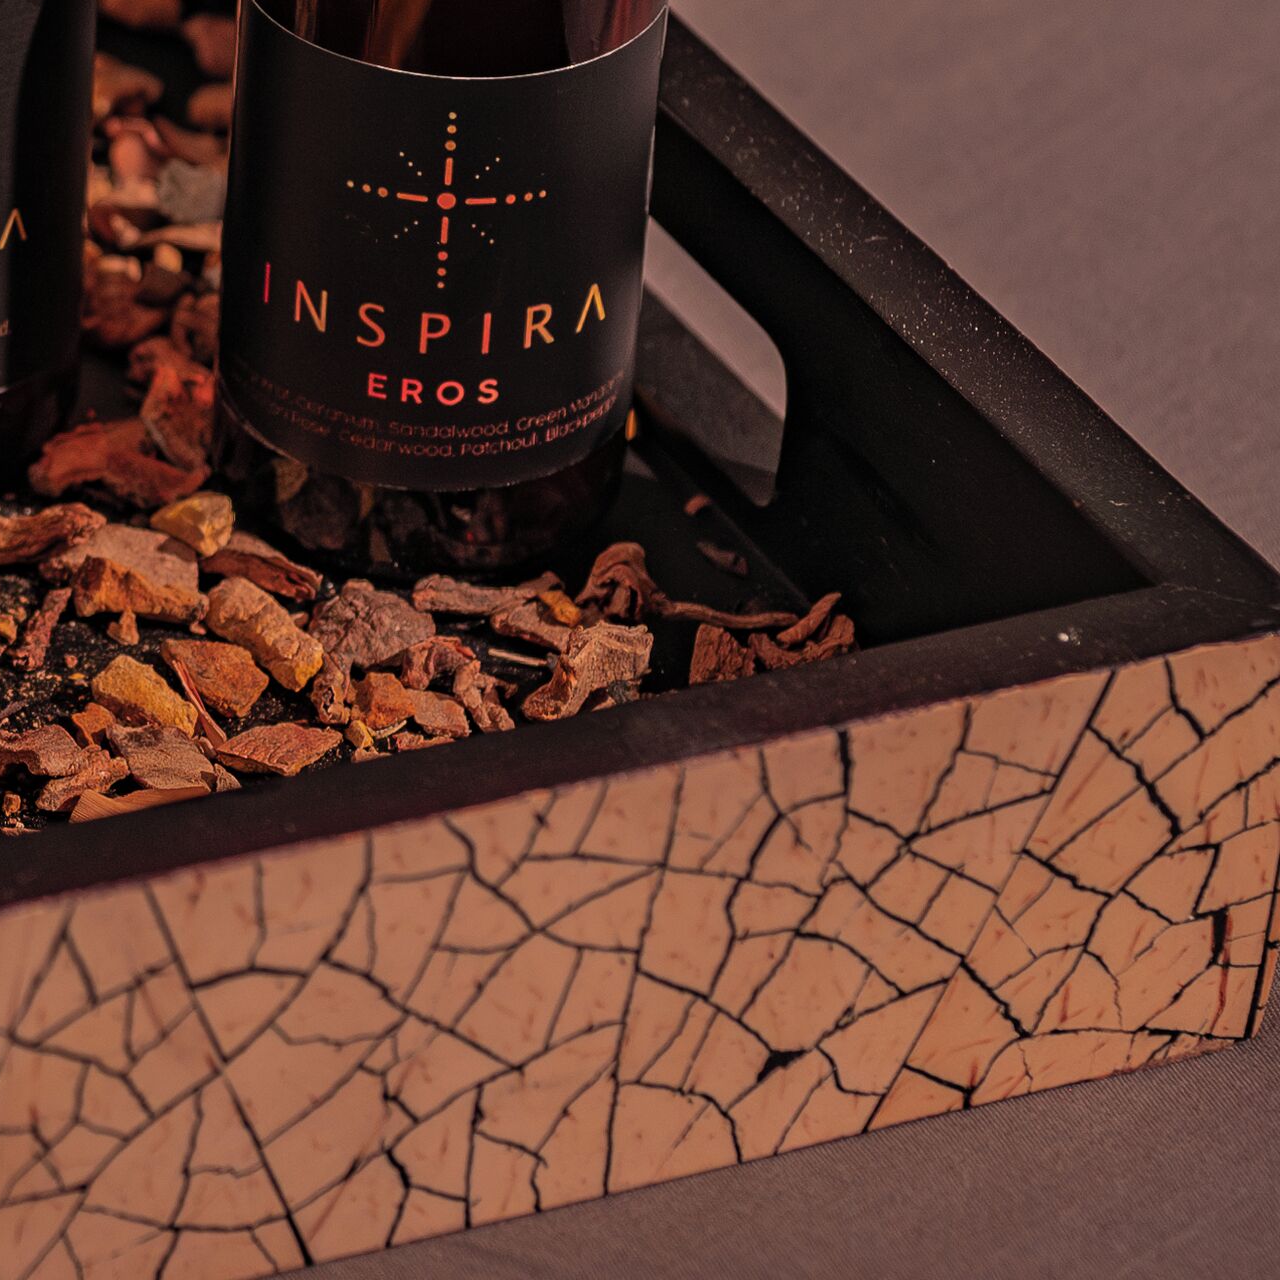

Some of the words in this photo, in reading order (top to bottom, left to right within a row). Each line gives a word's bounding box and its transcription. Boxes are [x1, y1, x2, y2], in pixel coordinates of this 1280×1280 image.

[263, 262, 606, 355] INSPIRA
[367, 372, 500, 406] EROS
[516, 406, 567, 431] Green
